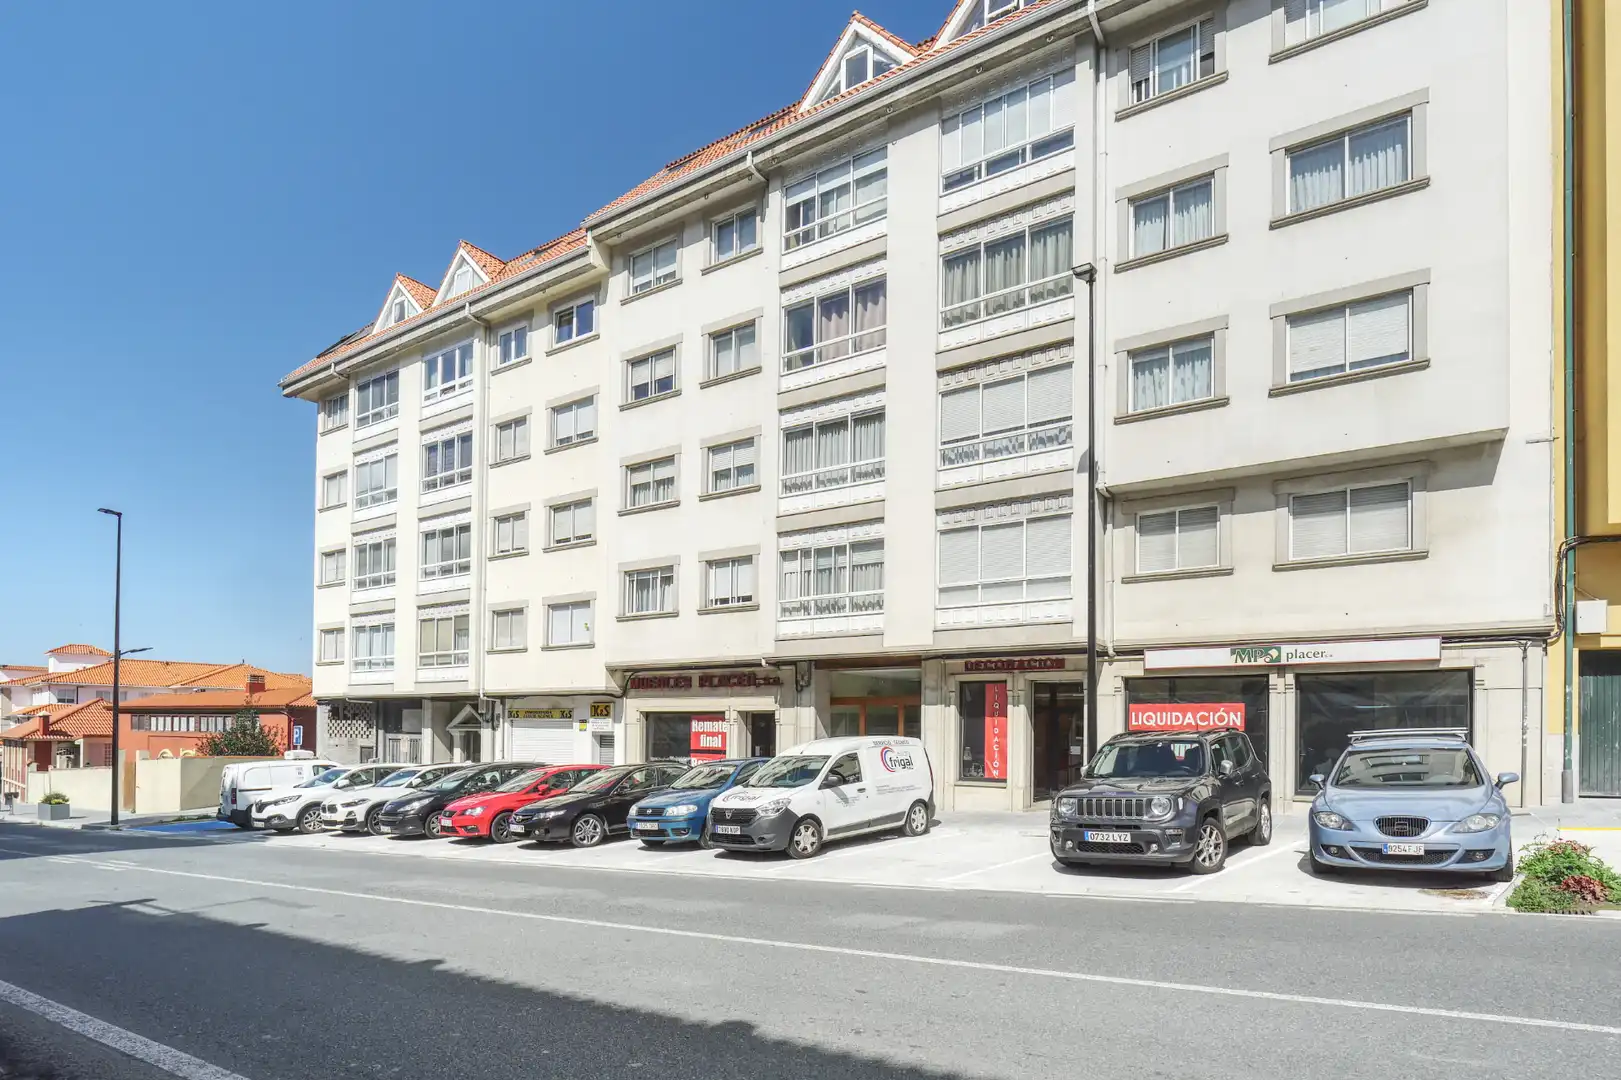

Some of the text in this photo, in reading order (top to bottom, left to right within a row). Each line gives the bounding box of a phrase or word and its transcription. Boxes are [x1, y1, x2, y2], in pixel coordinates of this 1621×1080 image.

[1286, 649, 1326, 662] placer
[1131, 707, 1242, 727] LIQUIDACIÓN
[692, 719, 728, 733] Remate
[992, 685, 1000, 777] LIQUIDACIÓN
[700, 734, 722, 748] final
[889, 755, 914, 770] frigal
[1090, 832, 1129, 842] 0732 LYZ
[1388, 844, 1407, 853] 9254
